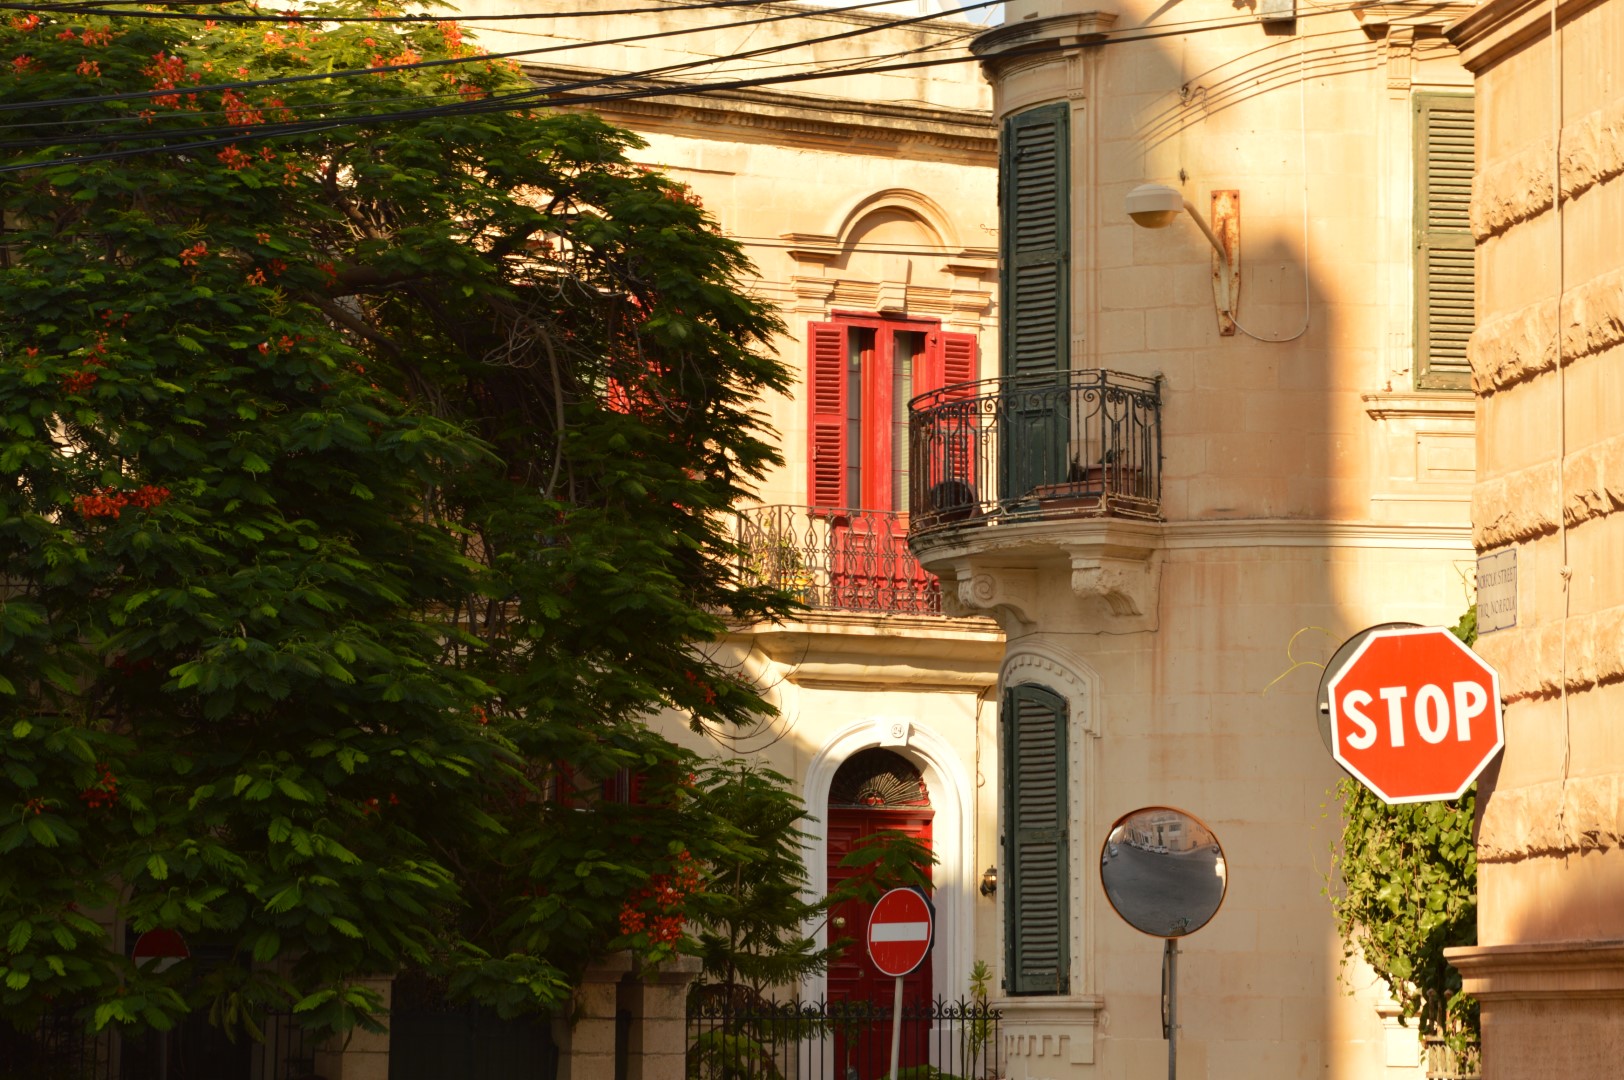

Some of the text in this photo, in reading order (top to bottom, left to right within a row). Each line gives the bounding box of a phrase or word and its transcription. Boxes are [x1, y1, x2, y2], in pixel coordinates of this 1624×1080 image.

[1477, 566, 1516, 589] NORFOLK STREET
[1478, 596, 1516, 618] TRIQ NORFOLK
[1342, 681, 1488, 750] STOP
